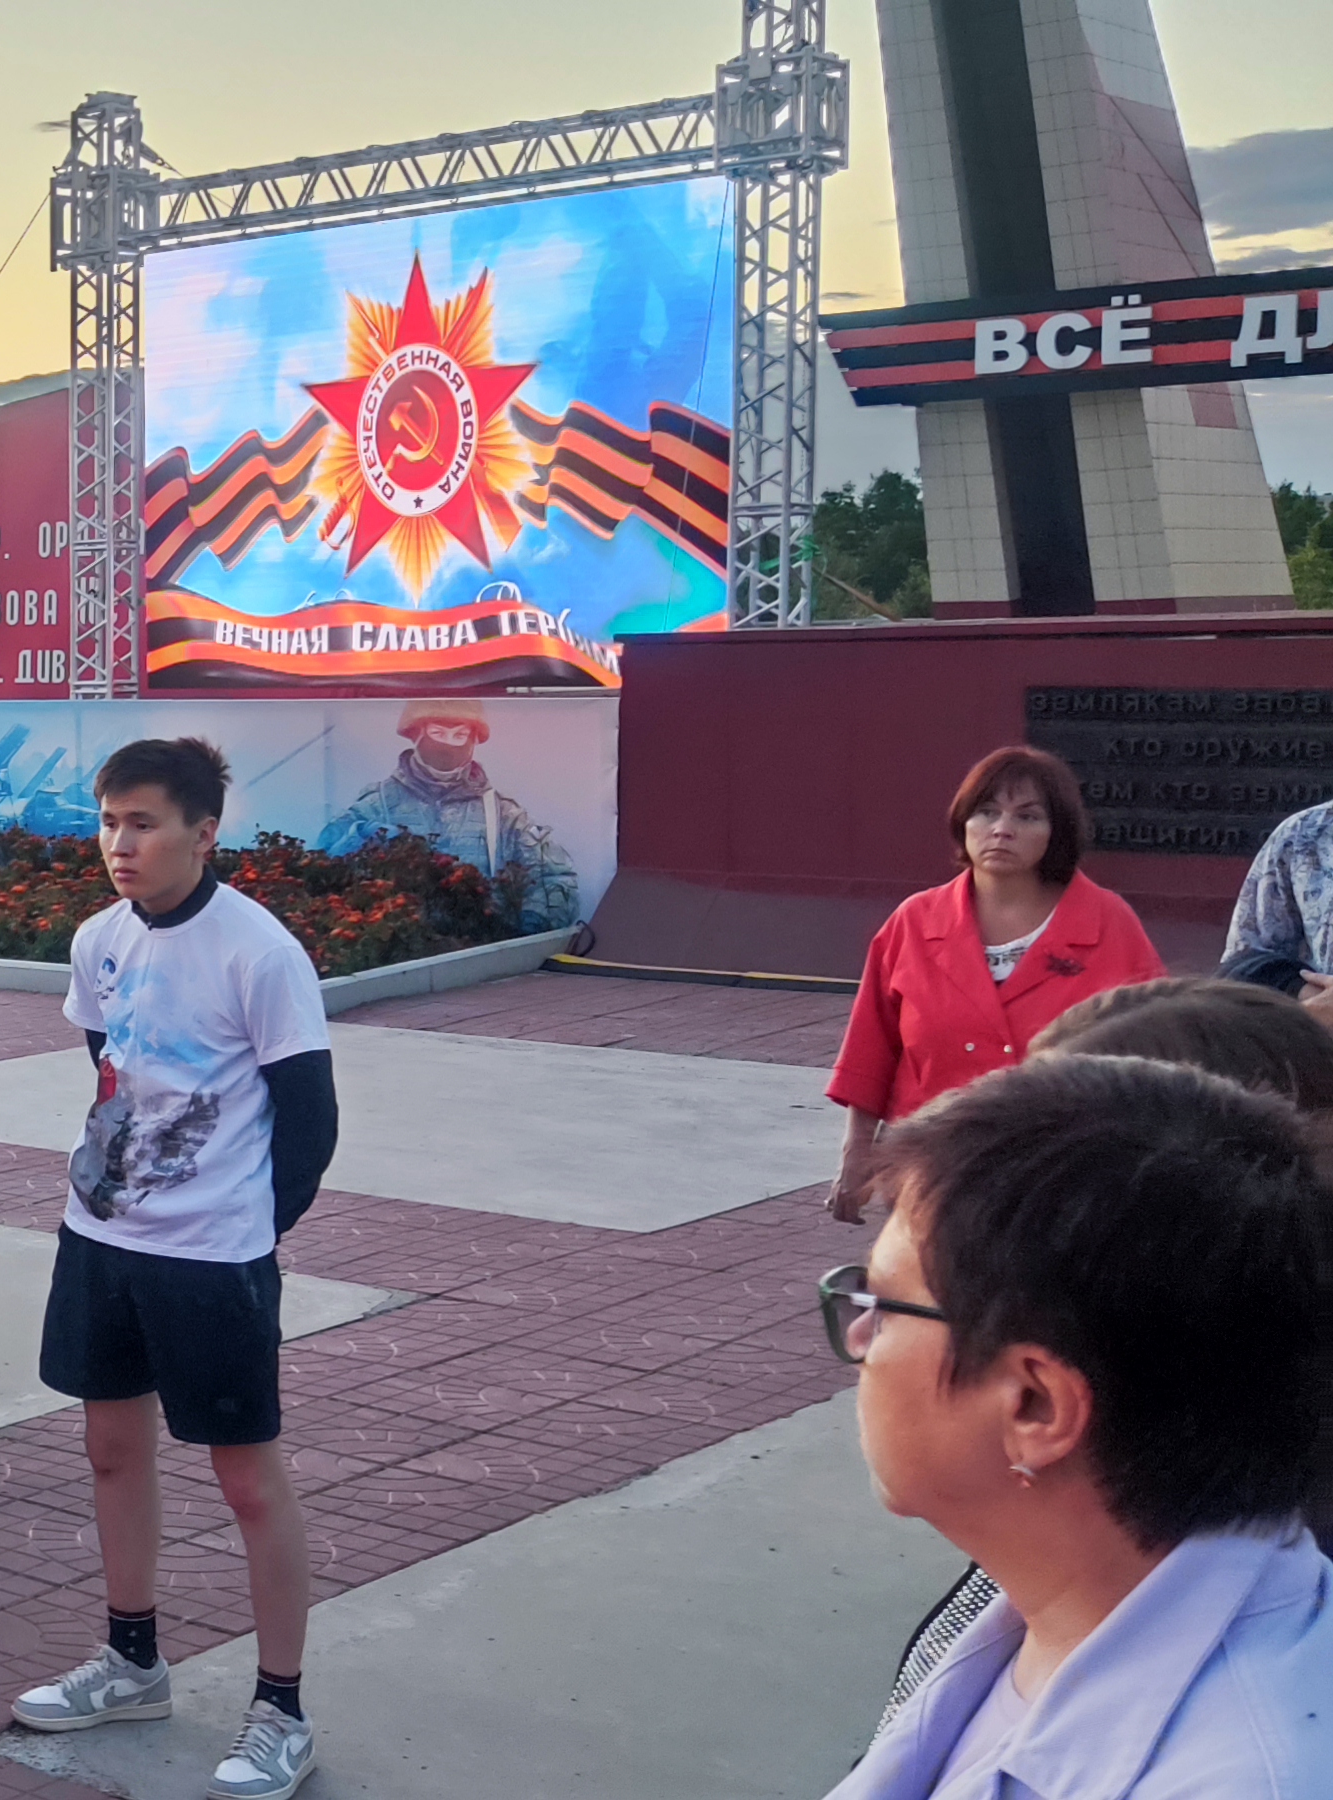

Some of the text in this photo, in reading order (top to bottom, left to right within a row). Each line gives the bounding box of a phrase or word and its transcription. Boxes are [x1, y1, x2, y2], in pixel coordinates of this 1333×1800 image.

[974, 295, 1153, 375] ВСЁ
[362, 349, 465, 501] ОТЕЧЕСТВЕННАЯ
[215, 618, 329, 655] ВЕЧНАЯ
[351, 619, 480, 651] СЛАВА
